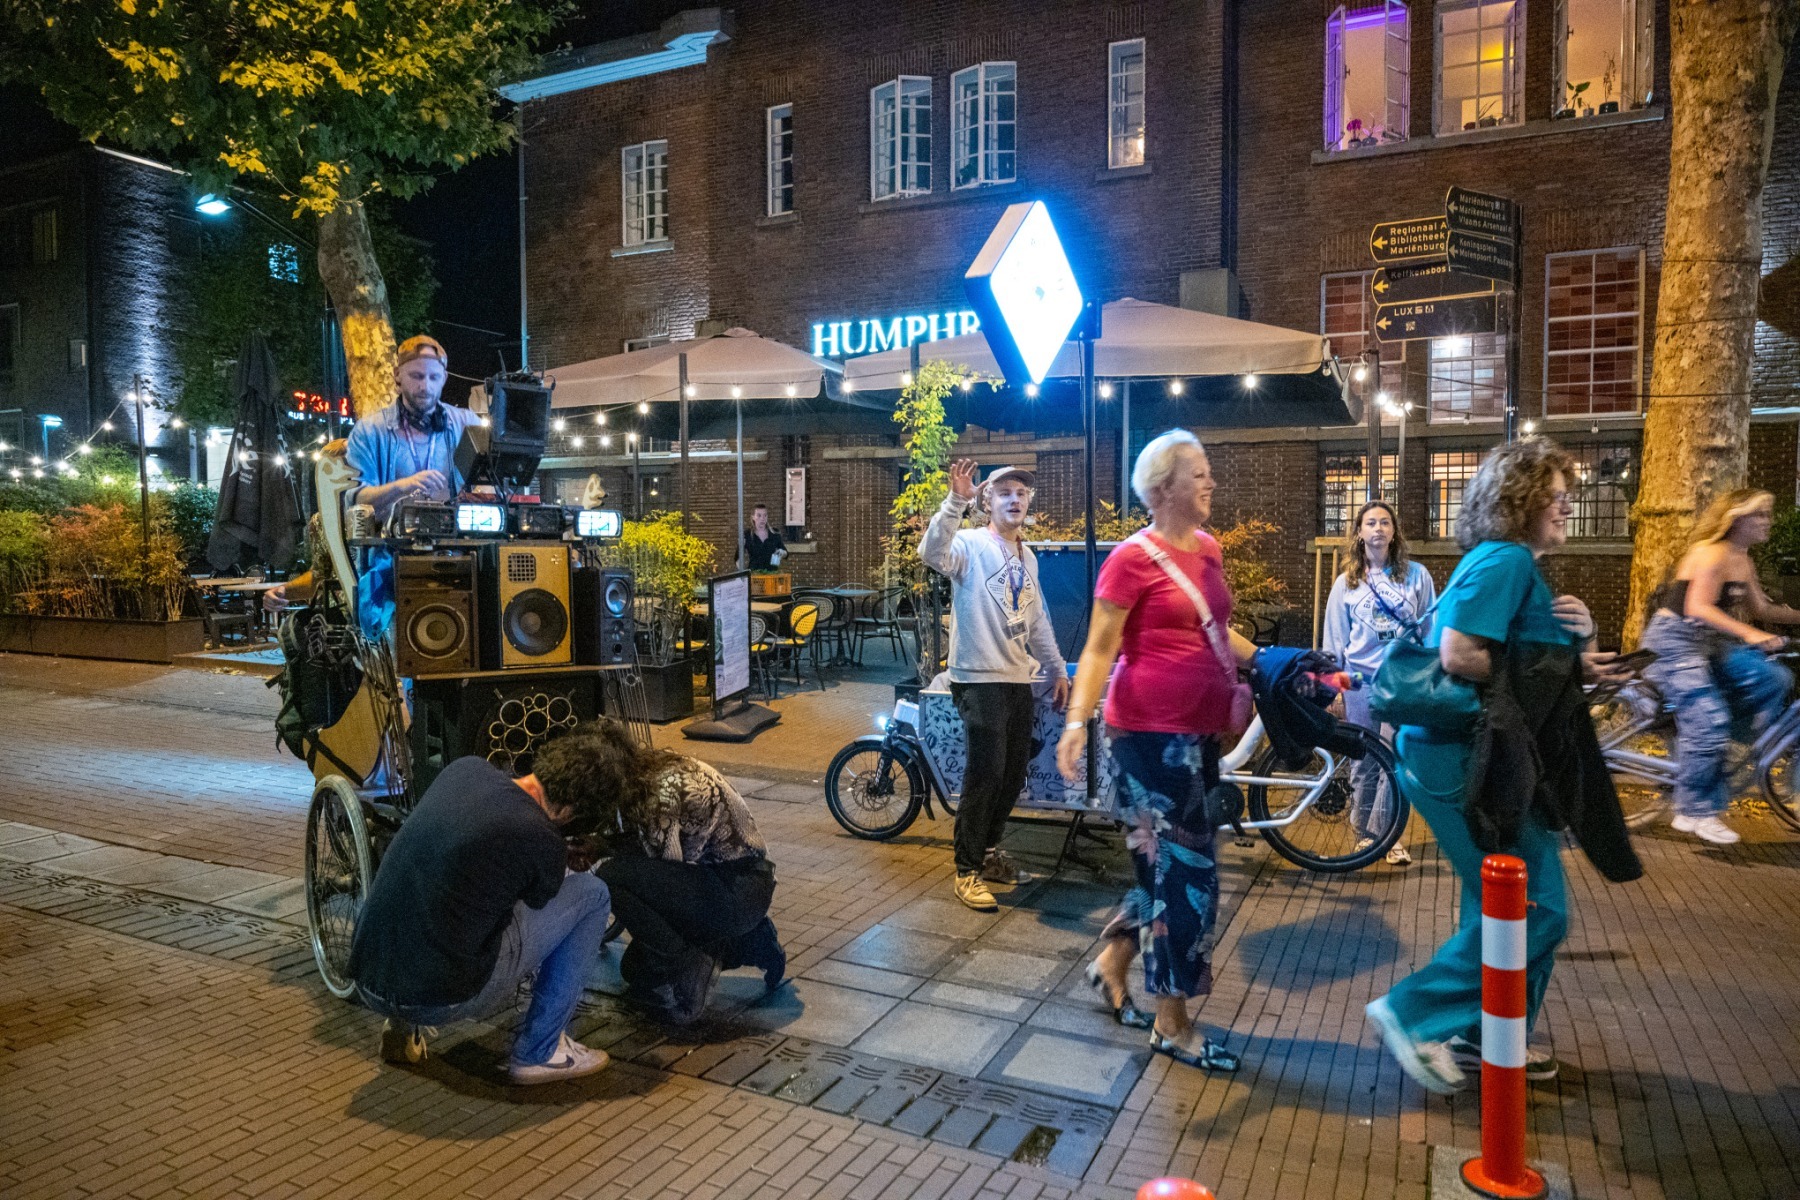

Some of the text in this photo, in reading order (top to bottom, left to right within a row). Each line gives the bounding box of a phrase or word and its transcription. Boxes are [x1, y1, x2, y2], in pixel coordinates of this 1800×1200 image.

[1390, 222, 1437, 236] Regionaal
[1390, 232, 1445, 245] Bibliotheek
[1394, 306, 1413, 317] LUX
